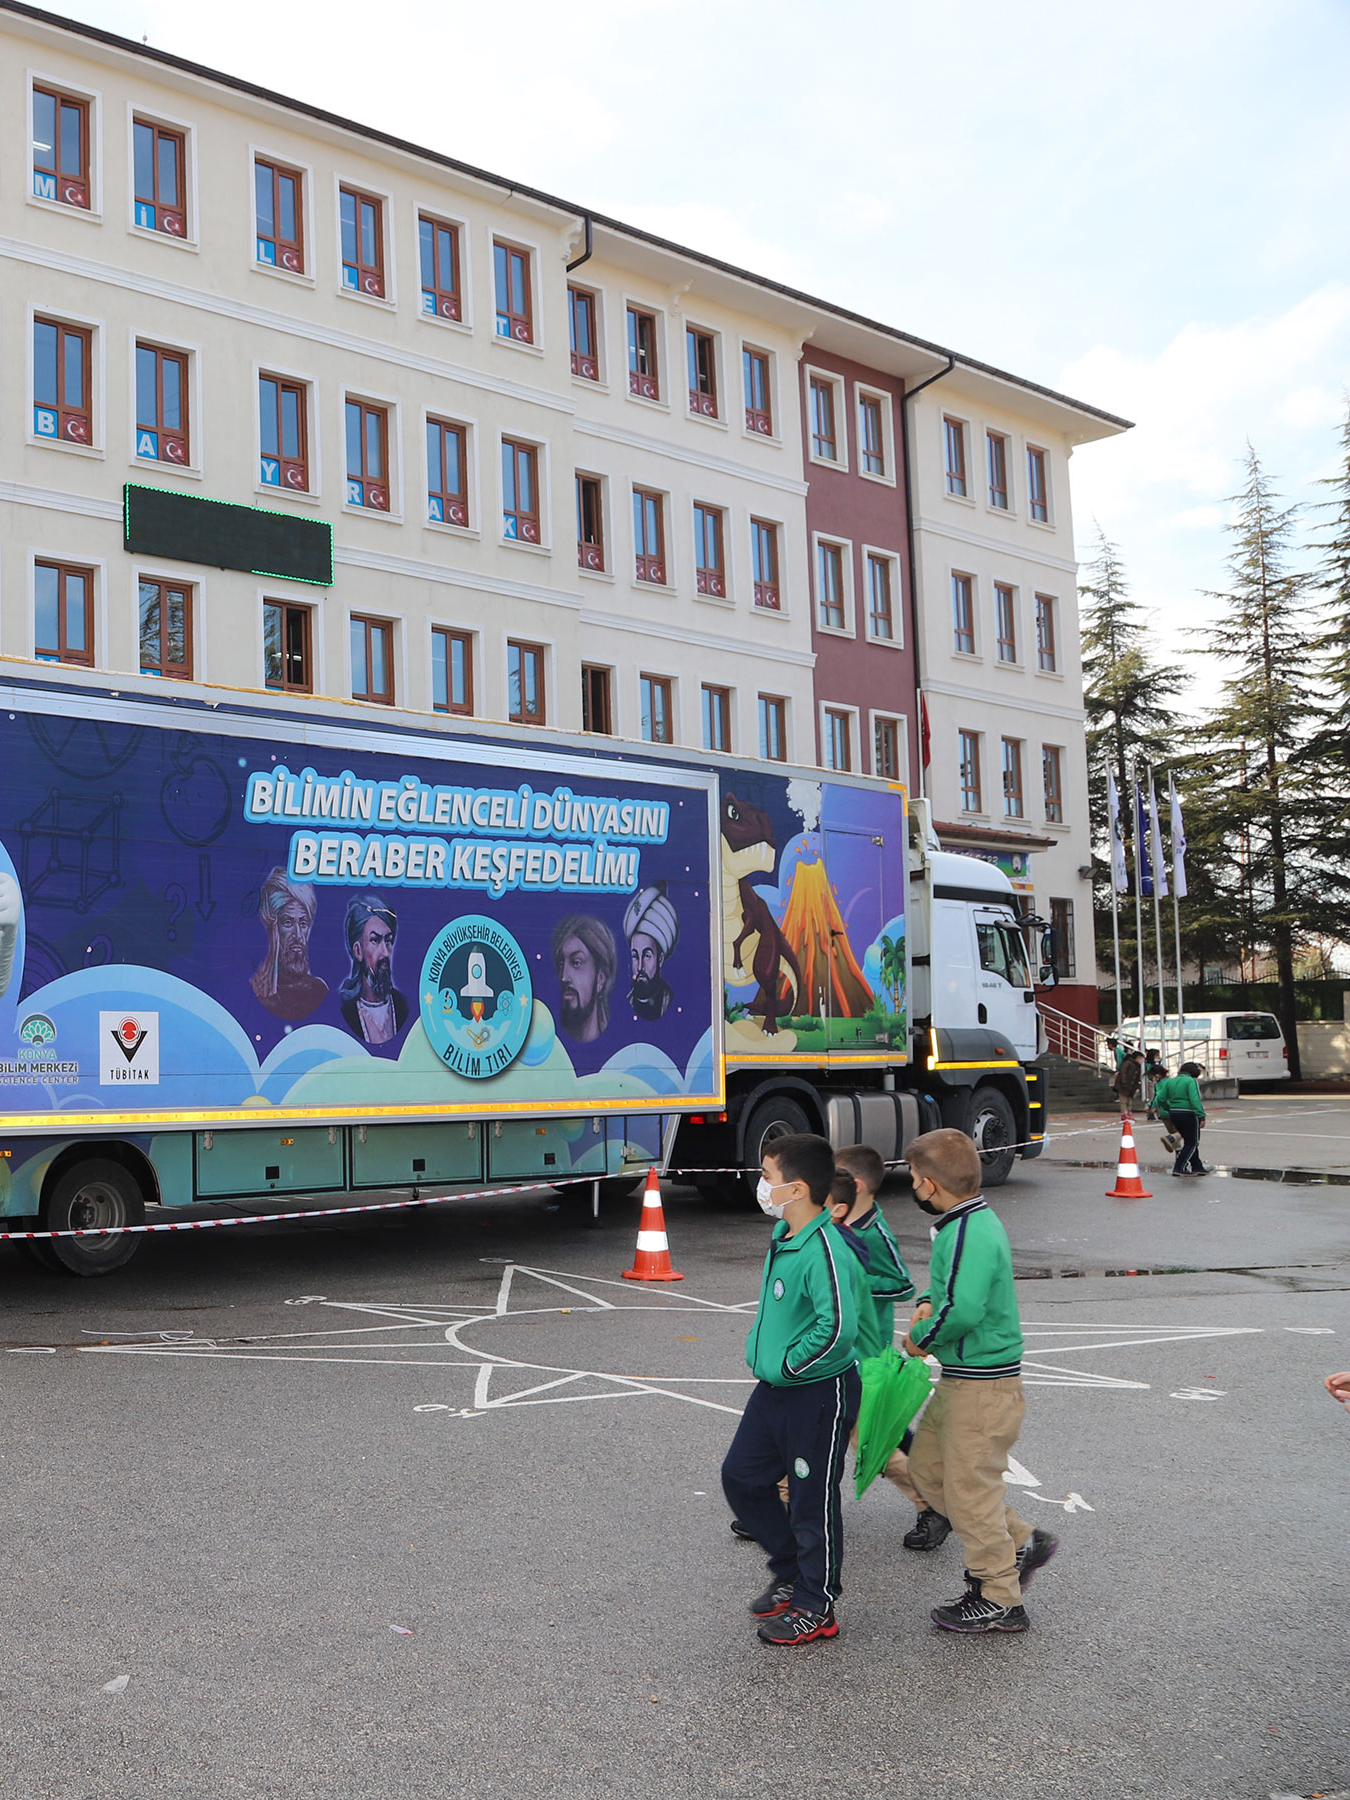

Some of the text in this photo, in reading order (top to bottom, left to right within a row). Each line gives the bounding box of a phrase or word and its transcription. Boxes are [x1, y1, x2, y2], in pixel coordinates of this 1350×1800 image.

[251, 773, 667, 837] BİLİMİN EĞLENCELİ DÜNYASINI
[294, 838, 636, 890] BERABER KEŞFEDELİM!
[428, 923, 525, 983] KONYA BÜYÜKŞEHİR BELEDİYESİ
[18, 1049, 57, 1060] KONYA
[443, 1043, 513, 1076] BİLİM TIRI
[30, 1062, 78, 1073] MERKEZİ
[110, 1068, 149, 1080] TÜBİTAK
[42, 1076, 78, 1084] CENTER
